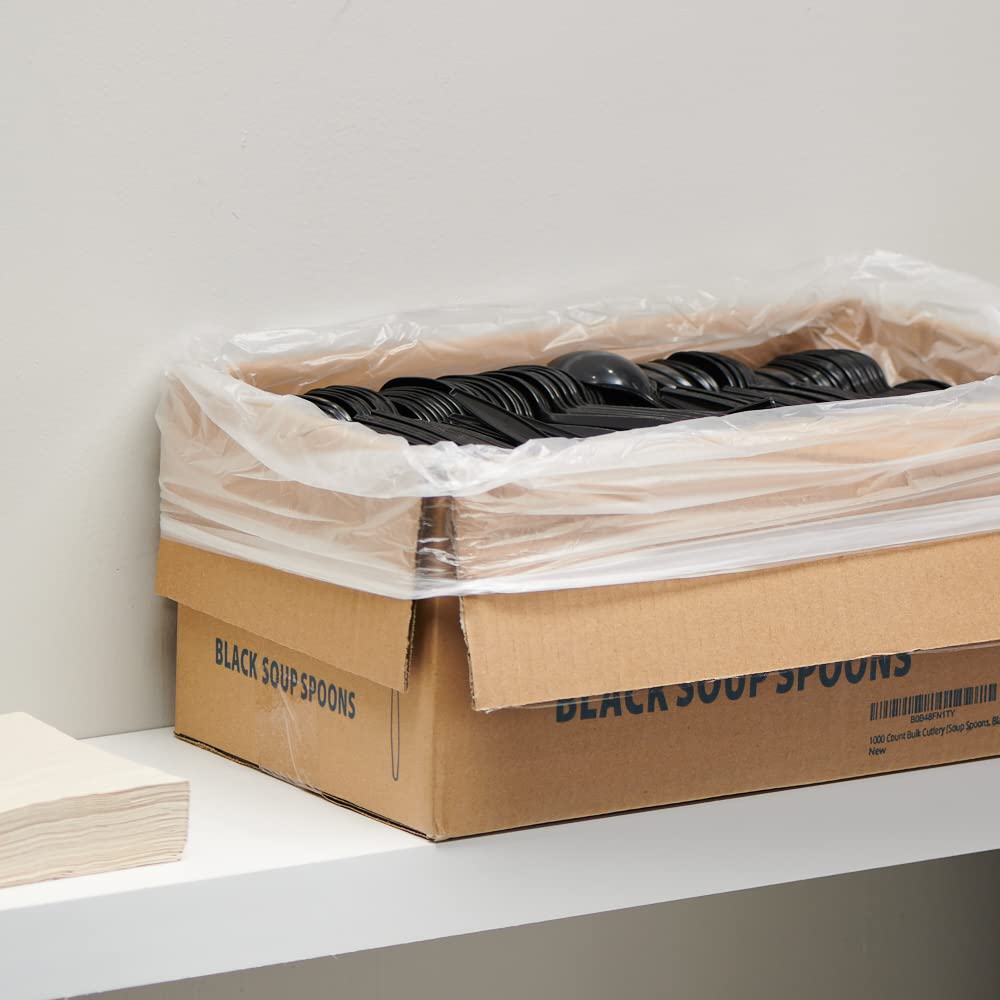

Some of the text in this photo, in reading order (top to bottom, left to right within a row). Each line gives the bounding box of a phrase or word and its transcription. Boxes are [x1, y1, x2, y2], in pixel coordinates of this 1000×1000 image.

[215, 637, 356, 719] BLACK SOUP SPOONS
[869, 736, 885, 745] 1000
[886, 733, 906, 743] Count
[906, 730, 921, 740] Bulk
[922, 726, 945, 737] Cutlery
[946, 724, 965, 734] (Soup
[965, 718, 991, 731] Spoons,
[868, 747, 887, 756] New
